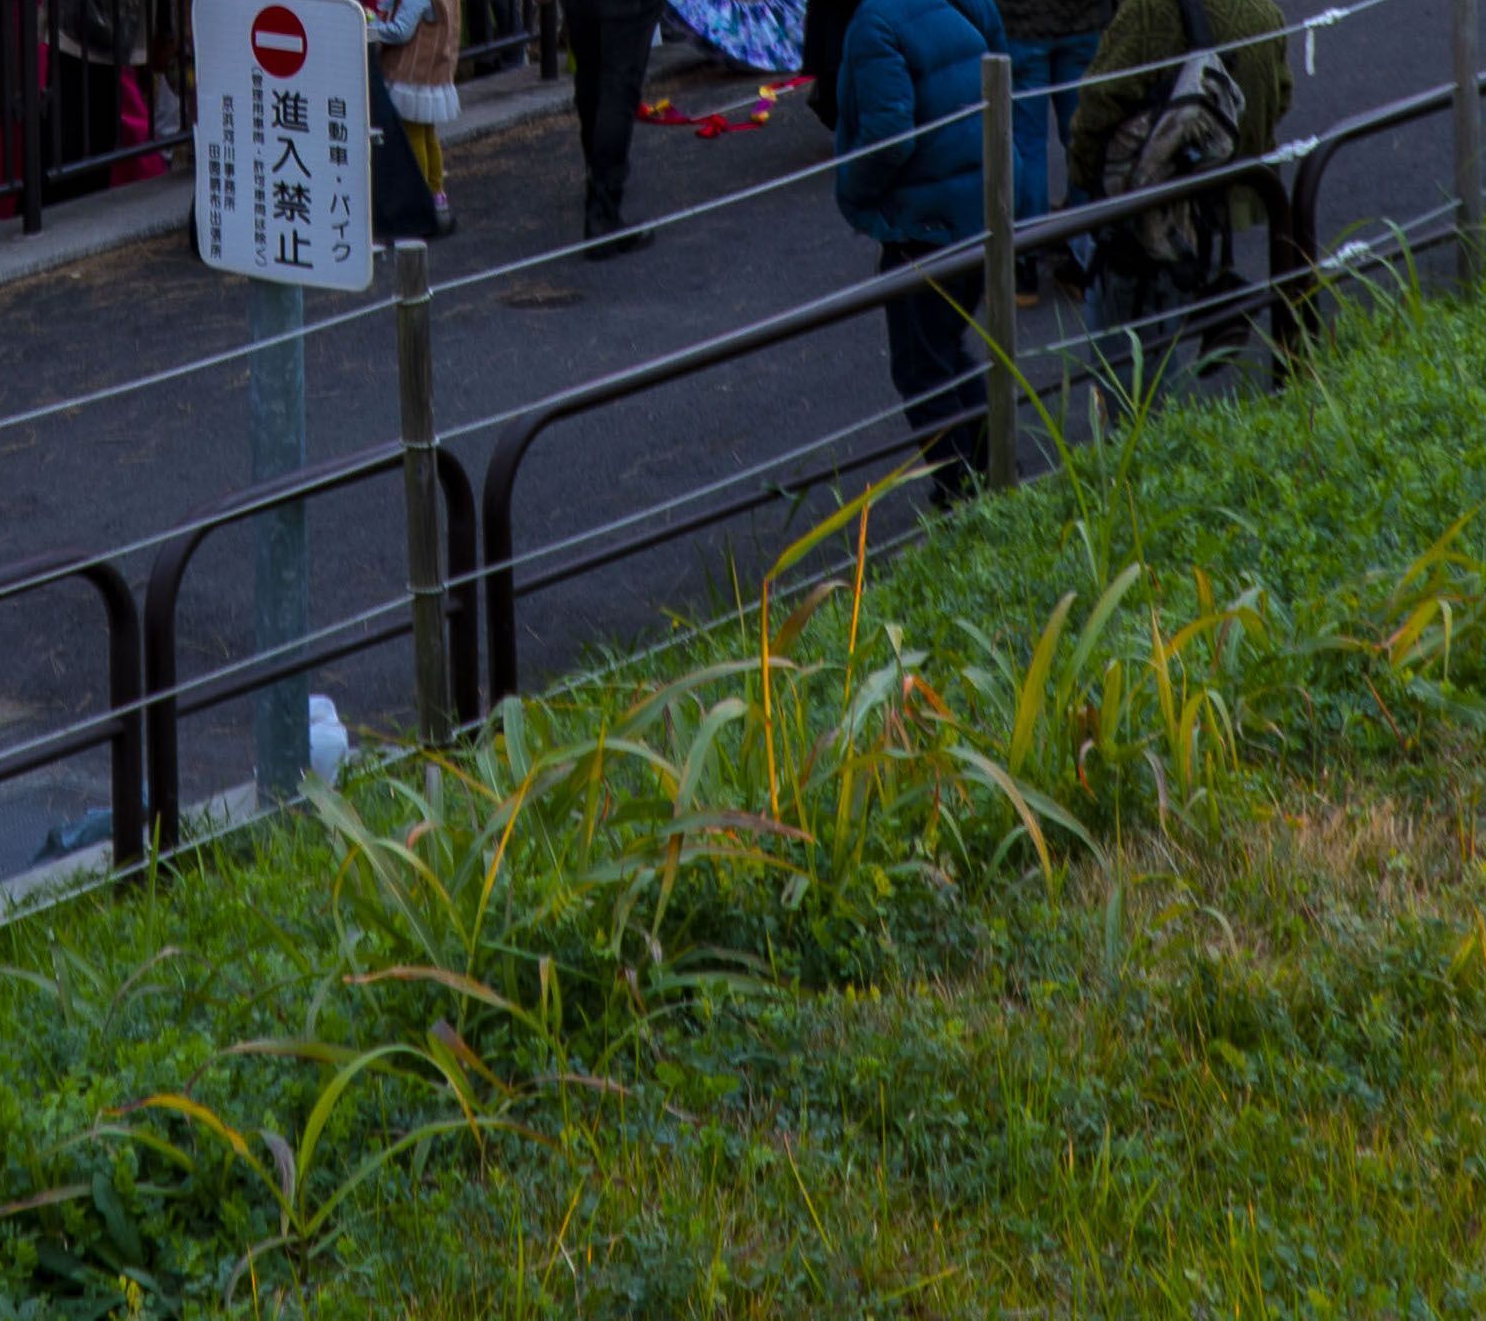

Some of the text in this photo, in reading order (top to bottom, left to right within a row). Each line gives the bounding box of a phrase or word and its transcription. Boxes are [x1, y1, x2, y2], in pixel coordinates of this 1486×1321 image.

[271, 90, 315, 270] 進入禁止
[327, 97, 352, 263] 自動車・バイク
